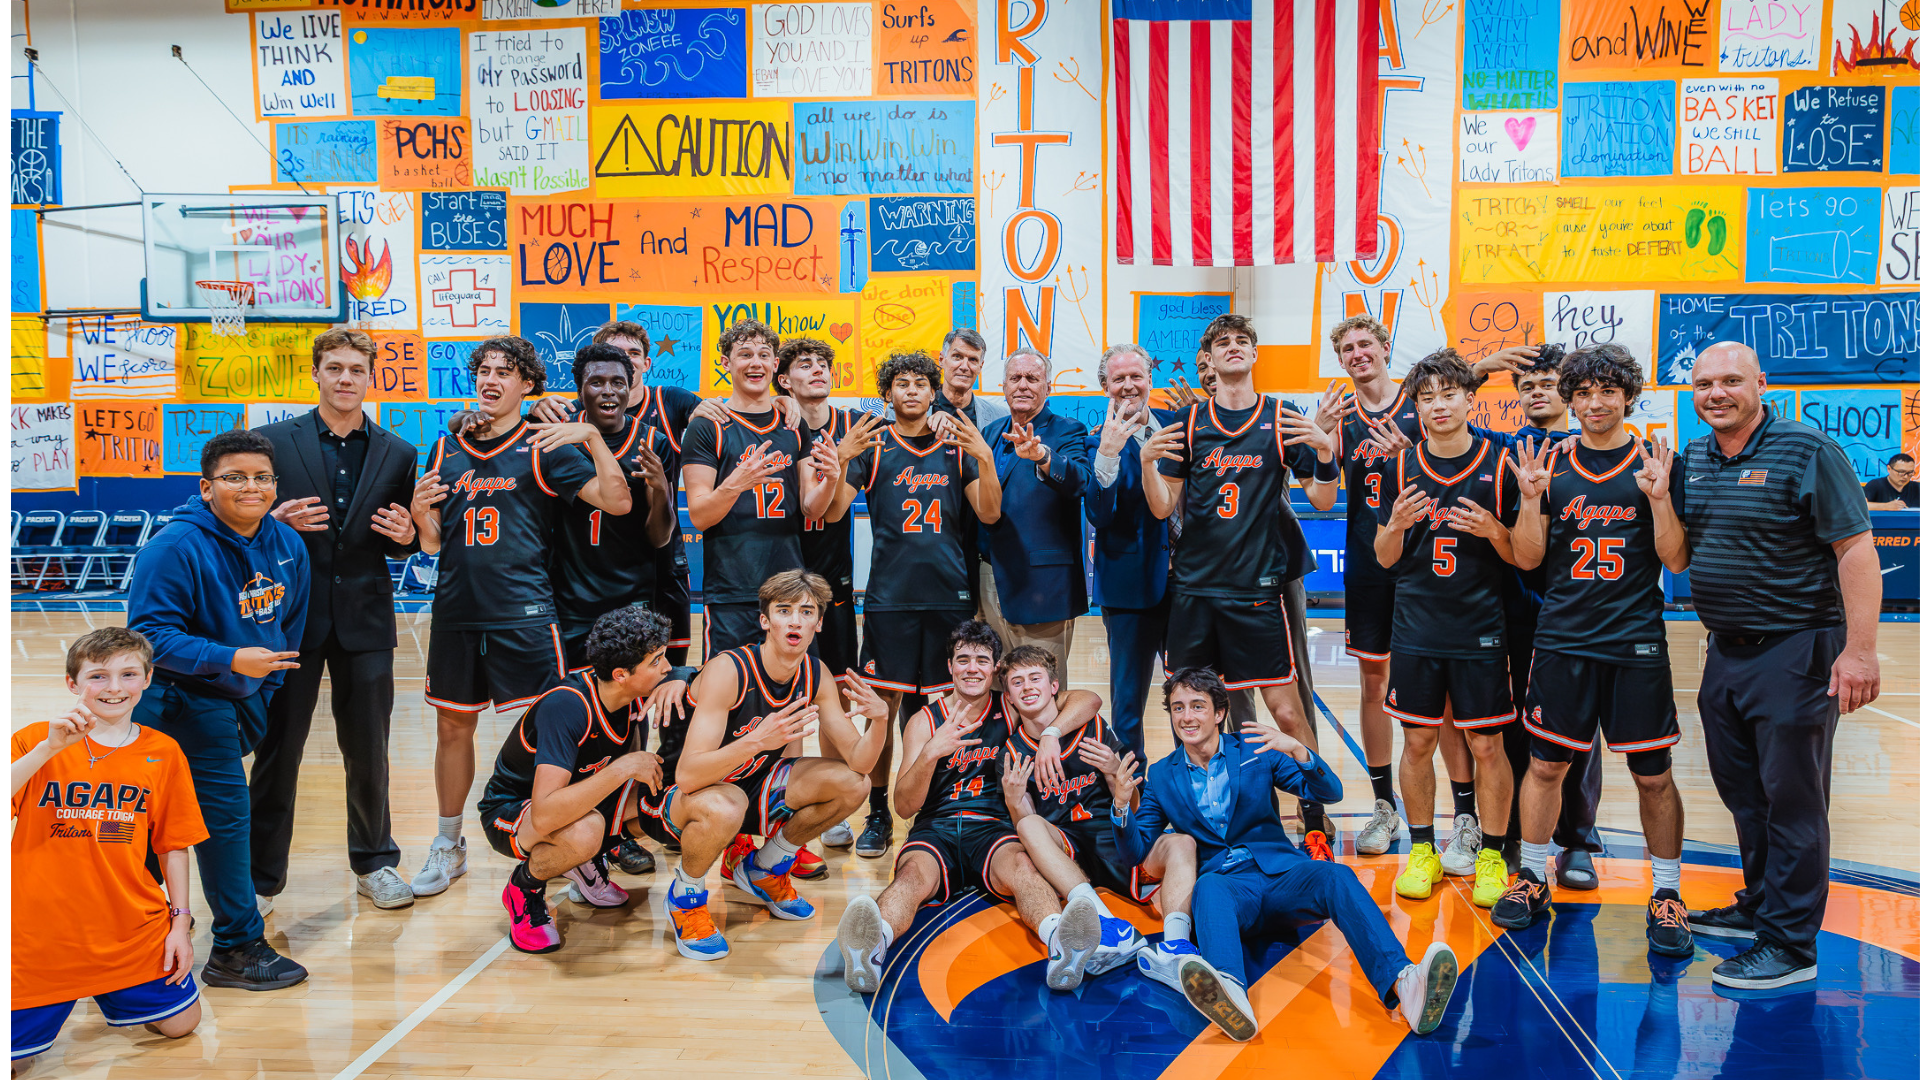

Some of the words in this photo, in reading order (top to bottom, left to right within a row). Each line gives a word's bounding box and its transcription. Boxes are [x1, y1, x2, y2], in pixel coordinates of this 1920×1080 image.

[261, 17, 294, 40] We
[302, 14, 340, 38] LIVE
[820, 5, 872, 37] LOVES
[882, 4, 936, 29] Surfs
[1727, 3, 1811, 33] LADY
[474, 34, 487, 52] I
[495, 31, 531, 51] tried
[543, 31, 564, 51] to
[600, 9, 676, 53] SPLASH
[910, 34, 930, 49] up
[1471, 17, 1528, 43] WIN
[1571, 22, 1627, 61] and
[260, 43, 333, 66] THINK
[500, 52, 546, 68] change
[618, 34, 683, 63] ZONEEE
[806, 40, 845, 62] AND
[847, 40, 866, 63] I
[1473, 43, 1528, 69] WIN
[281, 69, 315, 86] AND
[777, 66, 829, 94] LOVE
[884, 56, 974, 84] TRITONS
[1464, 71, 1489, 89] NO
[1496, 70, 1555, 90] MATTER
[486, 95, 504, 114] to
[514, 87, 585, 112] LOOSING
[1685, 85, 1716, 94] even
[1718, 84, 1744, 92] with
[1751, 83, 1765, 91] no
[1793, 90, 1821, 112] We
[1828, 87, 1879, 108] Refuse
[263, 93, 293, 111] Win
[300, 93, 336, 109] Well
[807, 107, 834, 125] all
[843, 111, 877, 121] we
[888, 104, 917, 120] do
[928, 107, 948, 121] is
[1568, 94, 1673, 122] TRITON
[1684, 95, 1777, 122] BASKET
[479, 117, 514, 144] but
[525, 115, 588, 142] GMAIL
[1463, 115, 1487, 136] We
[1820, 113, 1839, 125] to
[17, 118, 48, 149] THE
[287, 125, 308, 145] ITS
[316, 132, 372, 155] raining
[395, 122, 465, 160] PCHS
[911, 128, 957, 157] Win
[1583, 122, 1669, 147] NATION
[1788, 124, 1876, 165] LOSE
[498, 145, 529, 161] SAID
[536, 143, 558, 160] IT
[656, 114, 790, 180] CAUTION
[1466, 140, 1498, 154] our
[1571, 143, 1669, 165] domination
[1689, 143, 1773, 174] BALL
[431, 177, 453, 188] ball
[473, 165, 527, 188] Wasn't
[534, 165, 588, 189] Possible
[818, 171, 848, 185] no
[857, 164, 929, 183] matter
[934, 168, 973, 184] what
[1462, 159, 1500, 182] Lady
[1504, 159, 1554, 182] Tritons
[428, 192, 478, 210] Start
[1556, 197, 1597, 210] SMELL
[1604, 199, 1625, 208] our
[1761, 194, 1810, 218] lets
[1825, 196, 1858, 217] go
[452, 213, 476, 223] the
[878, 199, 975, 231] WARNING
[1556, 222, 1588, 233] cause
[1643, 219, 1675, 231] about
[431, 220, 507, 248] BUSES!
[521, 203, 614, 241] MUCH
[640, 227, 688, 255] And
[724, 203, 813, 248] MAD
[1475, 244, 1535, 259] TREAT
[1562, 245, 1575, 257] to
[1591, 245, 1622, 257] taste
[1627, 240, 1683, 256] DEFEAT
[1775, 246, 1831, 264] TRITONS
[427, 271, 446, 285] CALL
[480, 274, 490, 284] A
[519, 240, 620, 286] LOVE
[702, 244, 823, 291] Respect
[438, 291, 481, 304] lifeguard
[861, 284, 891, 302] We
[898, 280, 948, 299] don't
[637, 311, 693, 331] SHOOT
[778, 306, 826, 335] know
[1158, 300, 1184, 321] god
[1191, 301, 1223, 315] bless
[1469, 301, 1519, 332] GO
[1552, 295, 1623, 344] hey
[80, 315, 116, 345] WE
[1669, 296, 1726, 315] HOME
[1730, 299, 1920, 359] TRITON
[1670, 323, 1686, 345] of
[1694, 324, 1715, 340] the
[431, 344, 456, 360] GO
[681, 341, 701, 352] the
[78, 354, 116, 384] WE
[196, 354, 315, 398] ZONE
[36, 406, 71, 423] MAKES
[84, 409, 134, 430] LETS
[138, 411, 154, 432] GO
[1802, 402, 1899, 439] SHOOT
[25, 434, 68, 451] way
[33, 448, 70, 472] PLAY
[1202, 446, 1263, 477] Agape
[452, 469, 517, 500] Agape
[893, 465, 949, 494] Agape
[753, 482, 785, 519] 12
[1217, 482, 1240, 519] 3
[1560, 494, 1637, 531] Agape
[464, 506, 500, 546] 13
[589, 509, 602, 546] 1
[902, 498, 942, 533] 24
[1432, 537, 1458, 577] 5
[1570, 537, 1626, 581] 25
[946, 745, 1000, 773] Agape
[37, 781, 152, 813] AGAPE
[950, 775, 985, 800] 14
[56, 808, 104, 820] COURAGE
[50, 823, 93, 838] Tritons
